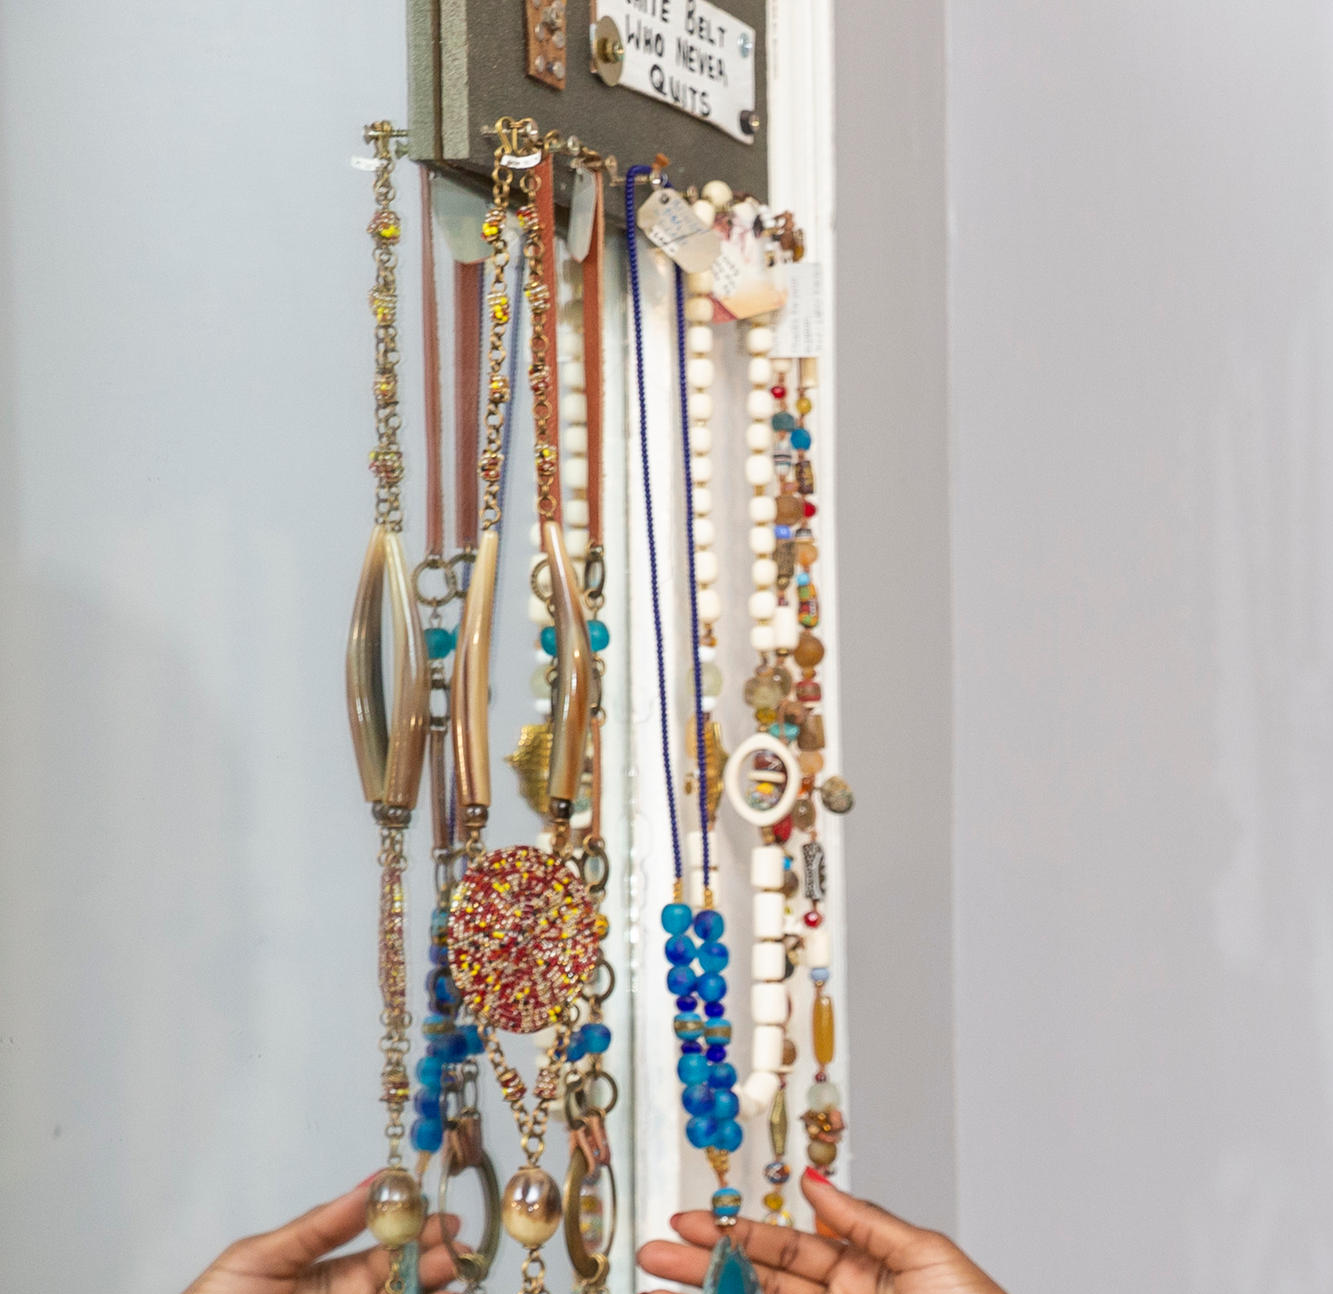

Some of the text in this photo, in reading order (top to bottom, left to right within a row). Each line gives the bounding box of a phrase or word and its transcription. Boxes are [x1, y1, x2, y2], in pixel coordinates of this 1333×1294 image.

[625, 14, 729, 87] WHO NEVER
[684, 0, 727, 48] BELT
[650, 64, 711, 117] QUITS
